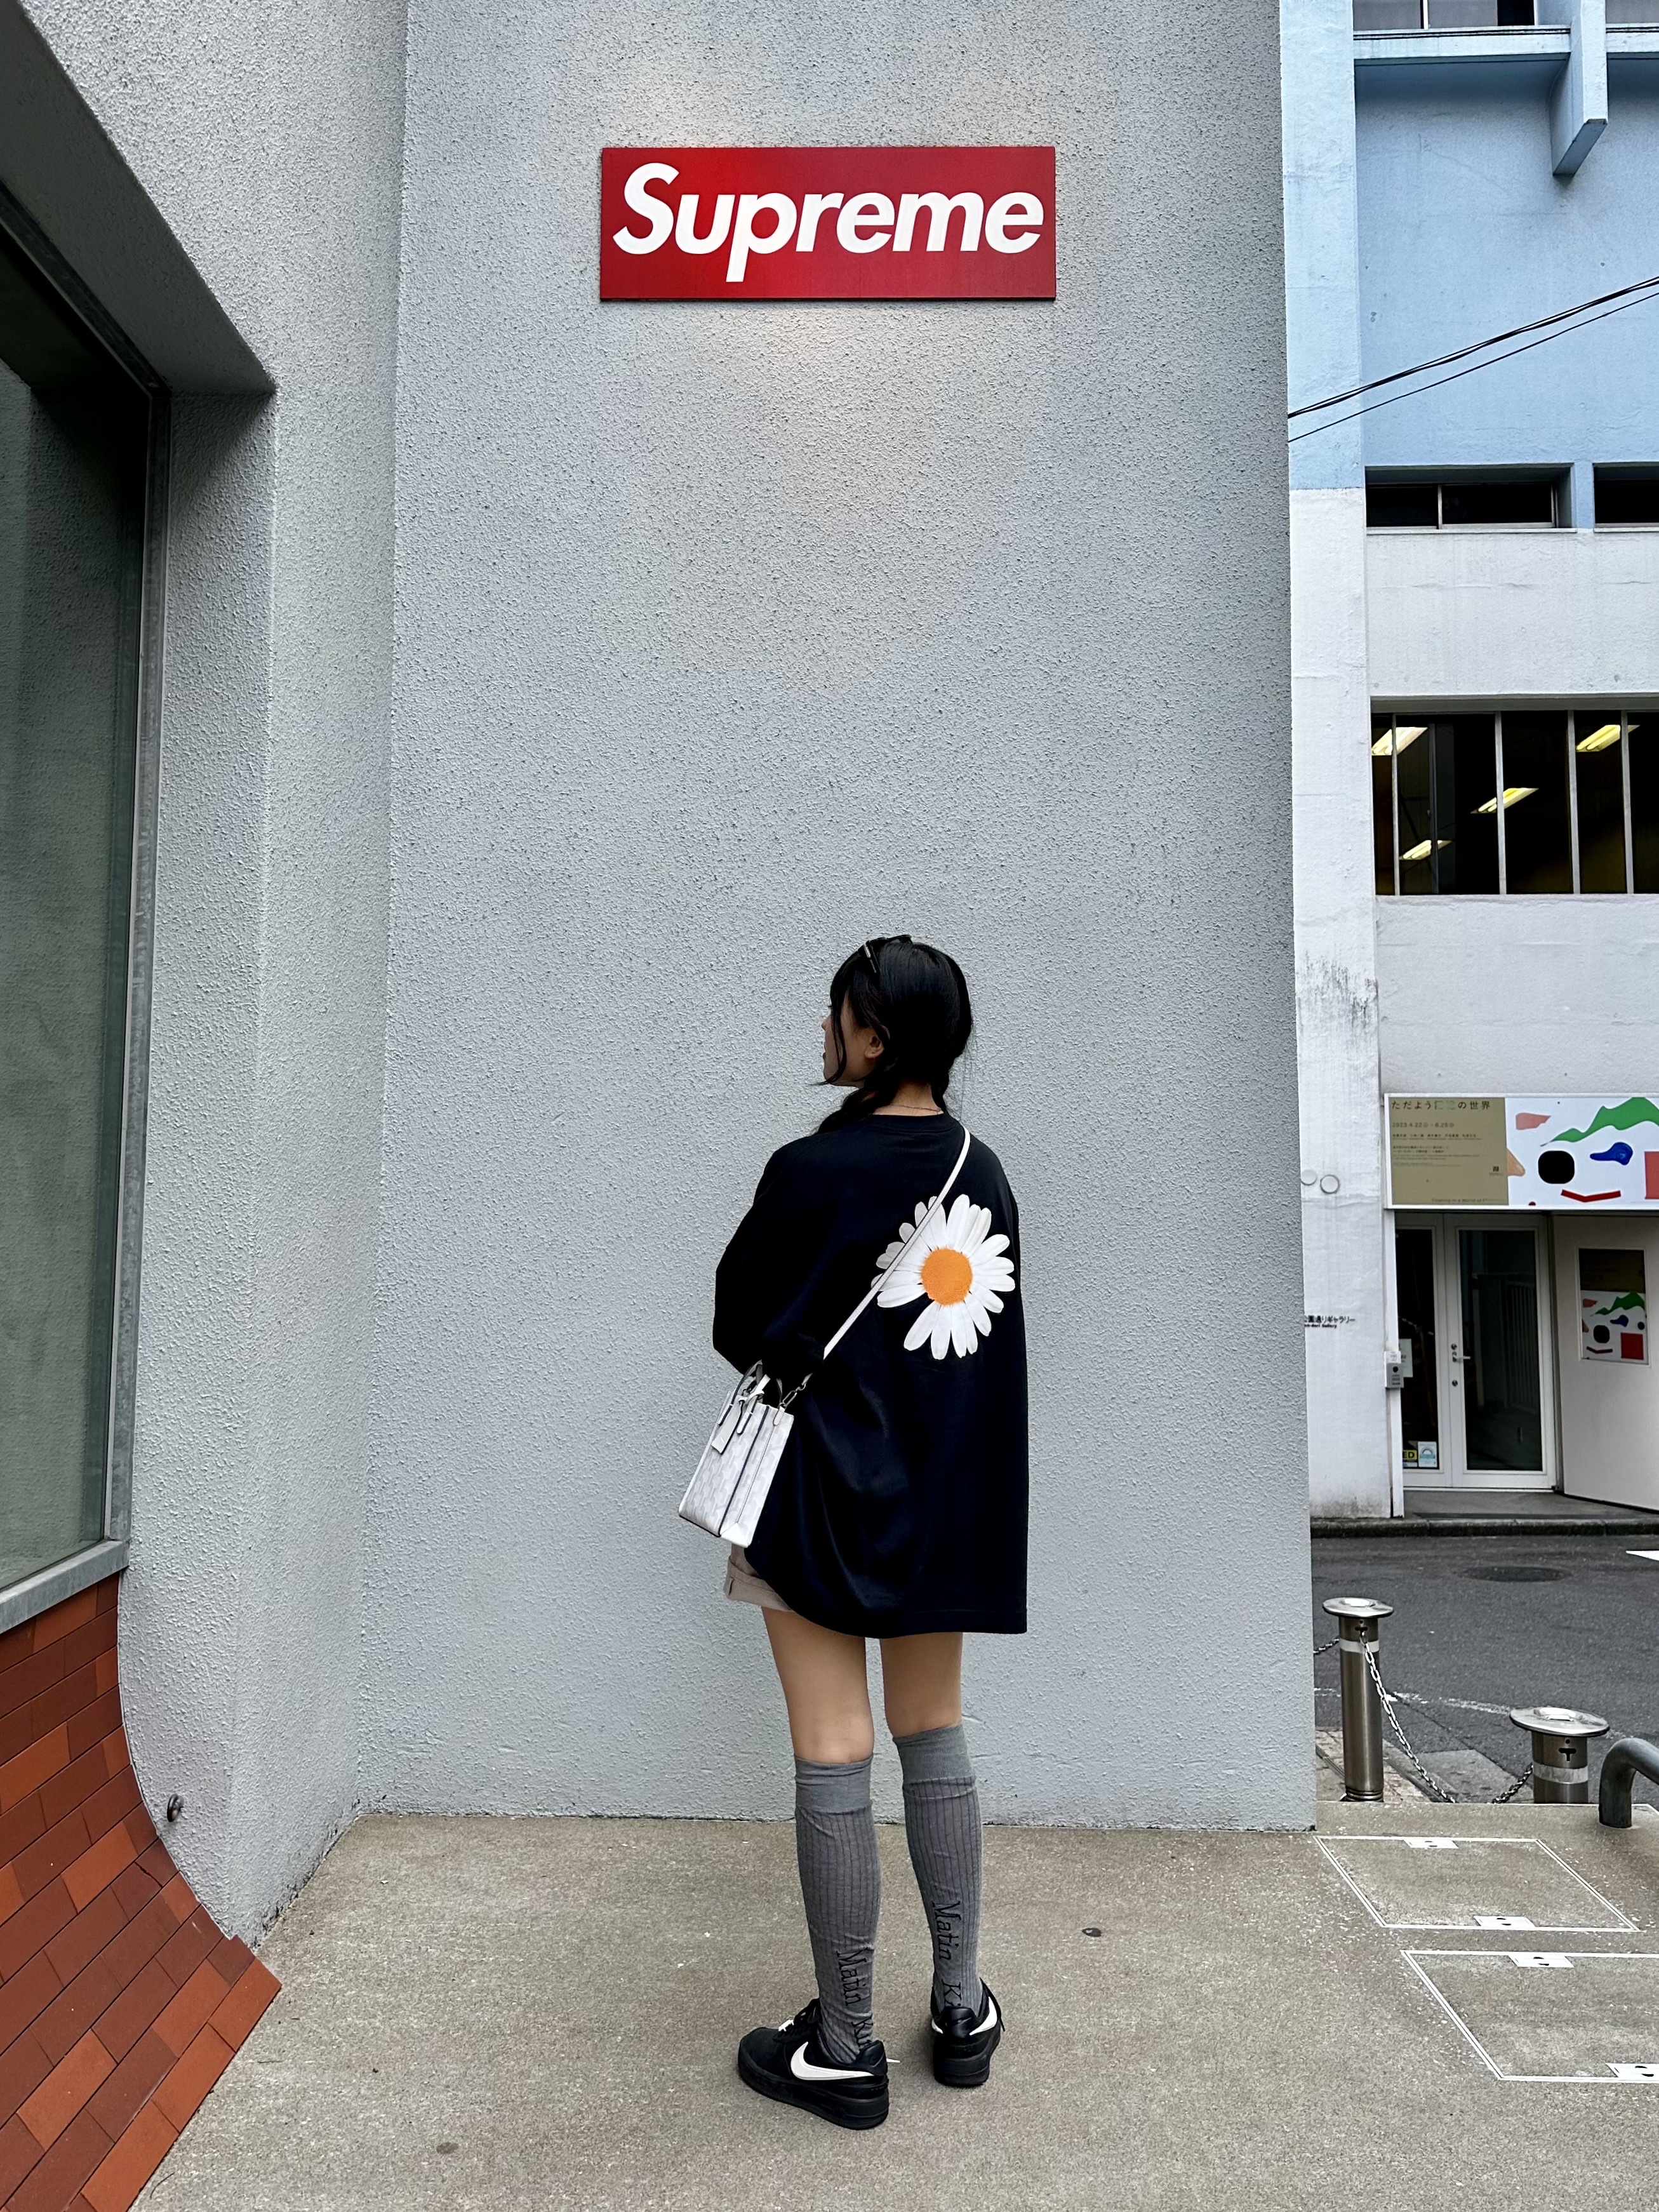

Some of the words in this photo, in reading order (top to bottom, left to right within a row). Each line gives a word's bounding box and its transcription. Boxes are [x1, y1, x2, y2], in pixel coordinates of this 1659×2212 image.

[613, 163, 1044, 282] Supreme
[931, 1900, 962, 1961] Matin
[836, 1947, 874, 2006] Matin
